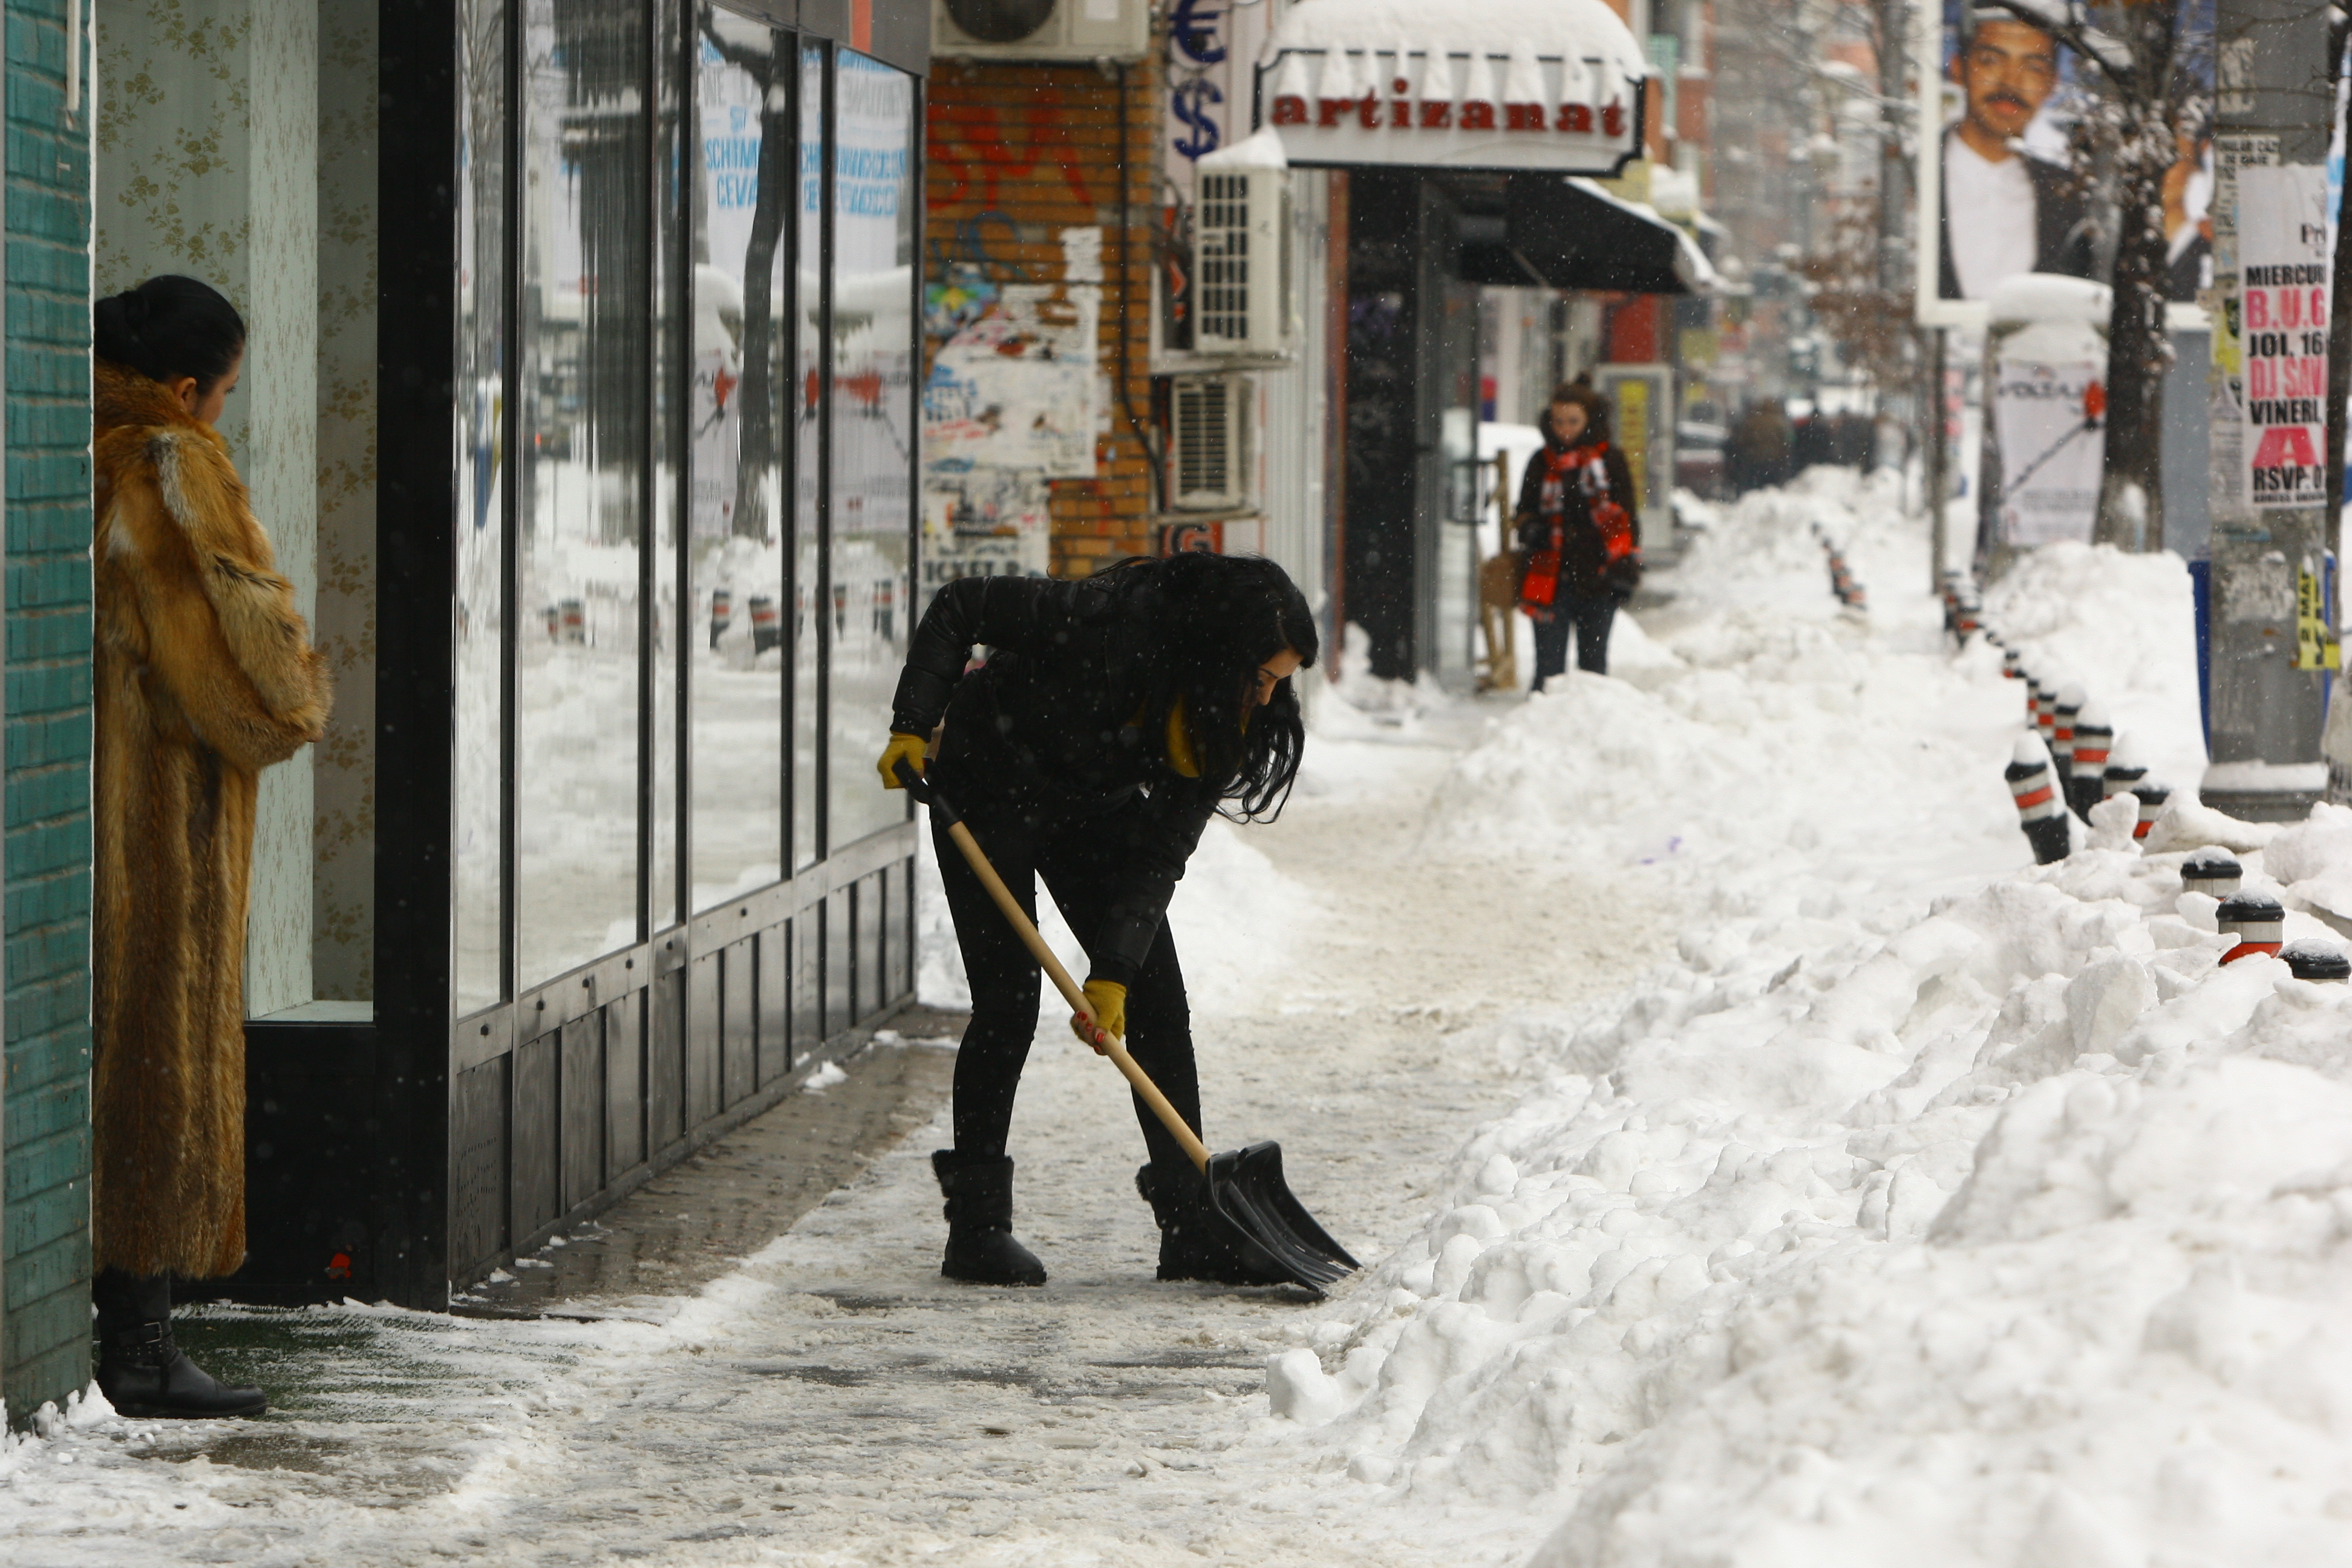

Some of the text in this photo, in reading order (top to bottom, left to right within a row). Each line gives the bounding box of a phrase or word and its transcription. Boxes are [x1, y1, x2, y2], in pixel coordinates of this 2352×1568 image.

[1272, 76, 1625, 137] artizanat
[706, 138, 759, 169] SCHIM
[2250, 359, 2277, 399] DJ
[2251, 426, 2328, 468] A
